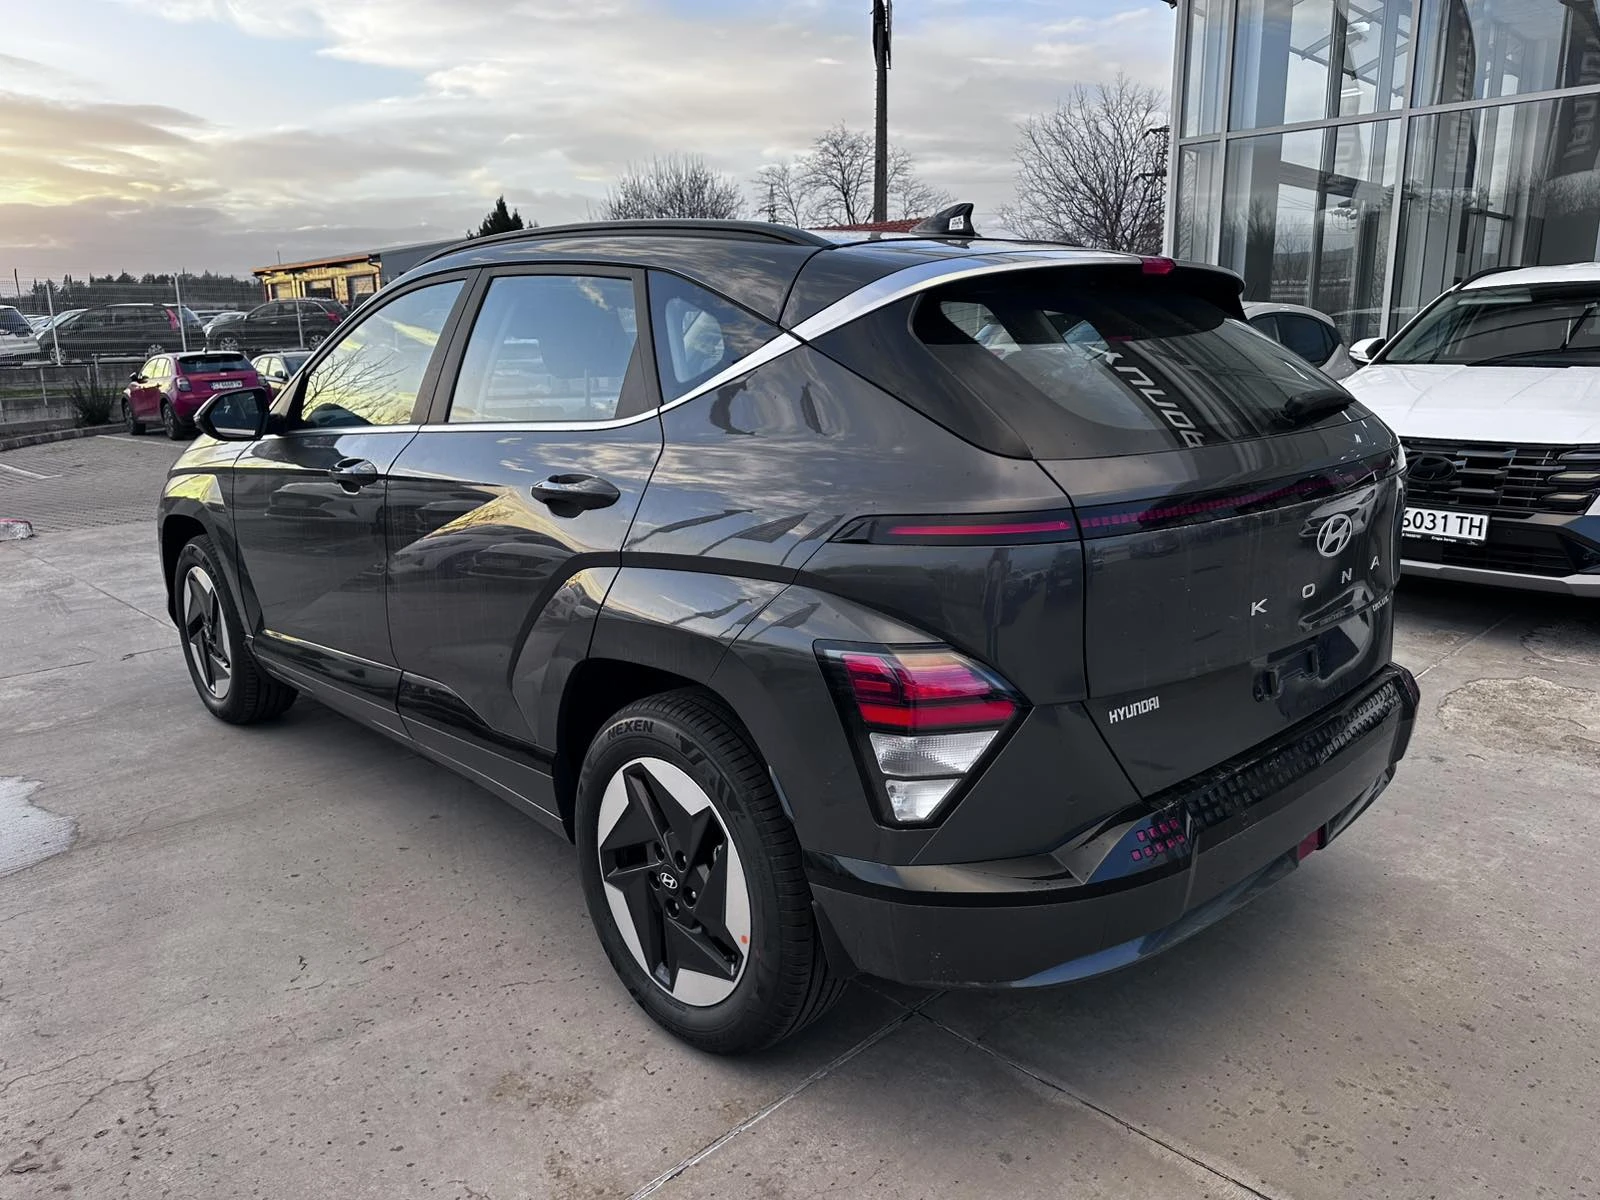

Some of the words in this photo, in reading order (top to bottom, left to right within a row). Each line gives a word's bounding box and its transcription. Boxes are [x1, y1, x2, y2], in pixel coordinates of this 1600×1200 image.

[1455, 515, 1484, 537] TH
[1250, 555, 1380, 617] KONA
[1108, 696, 1160, 724] HYUNDAI
[608, 720, 654, 740] NEXEN
